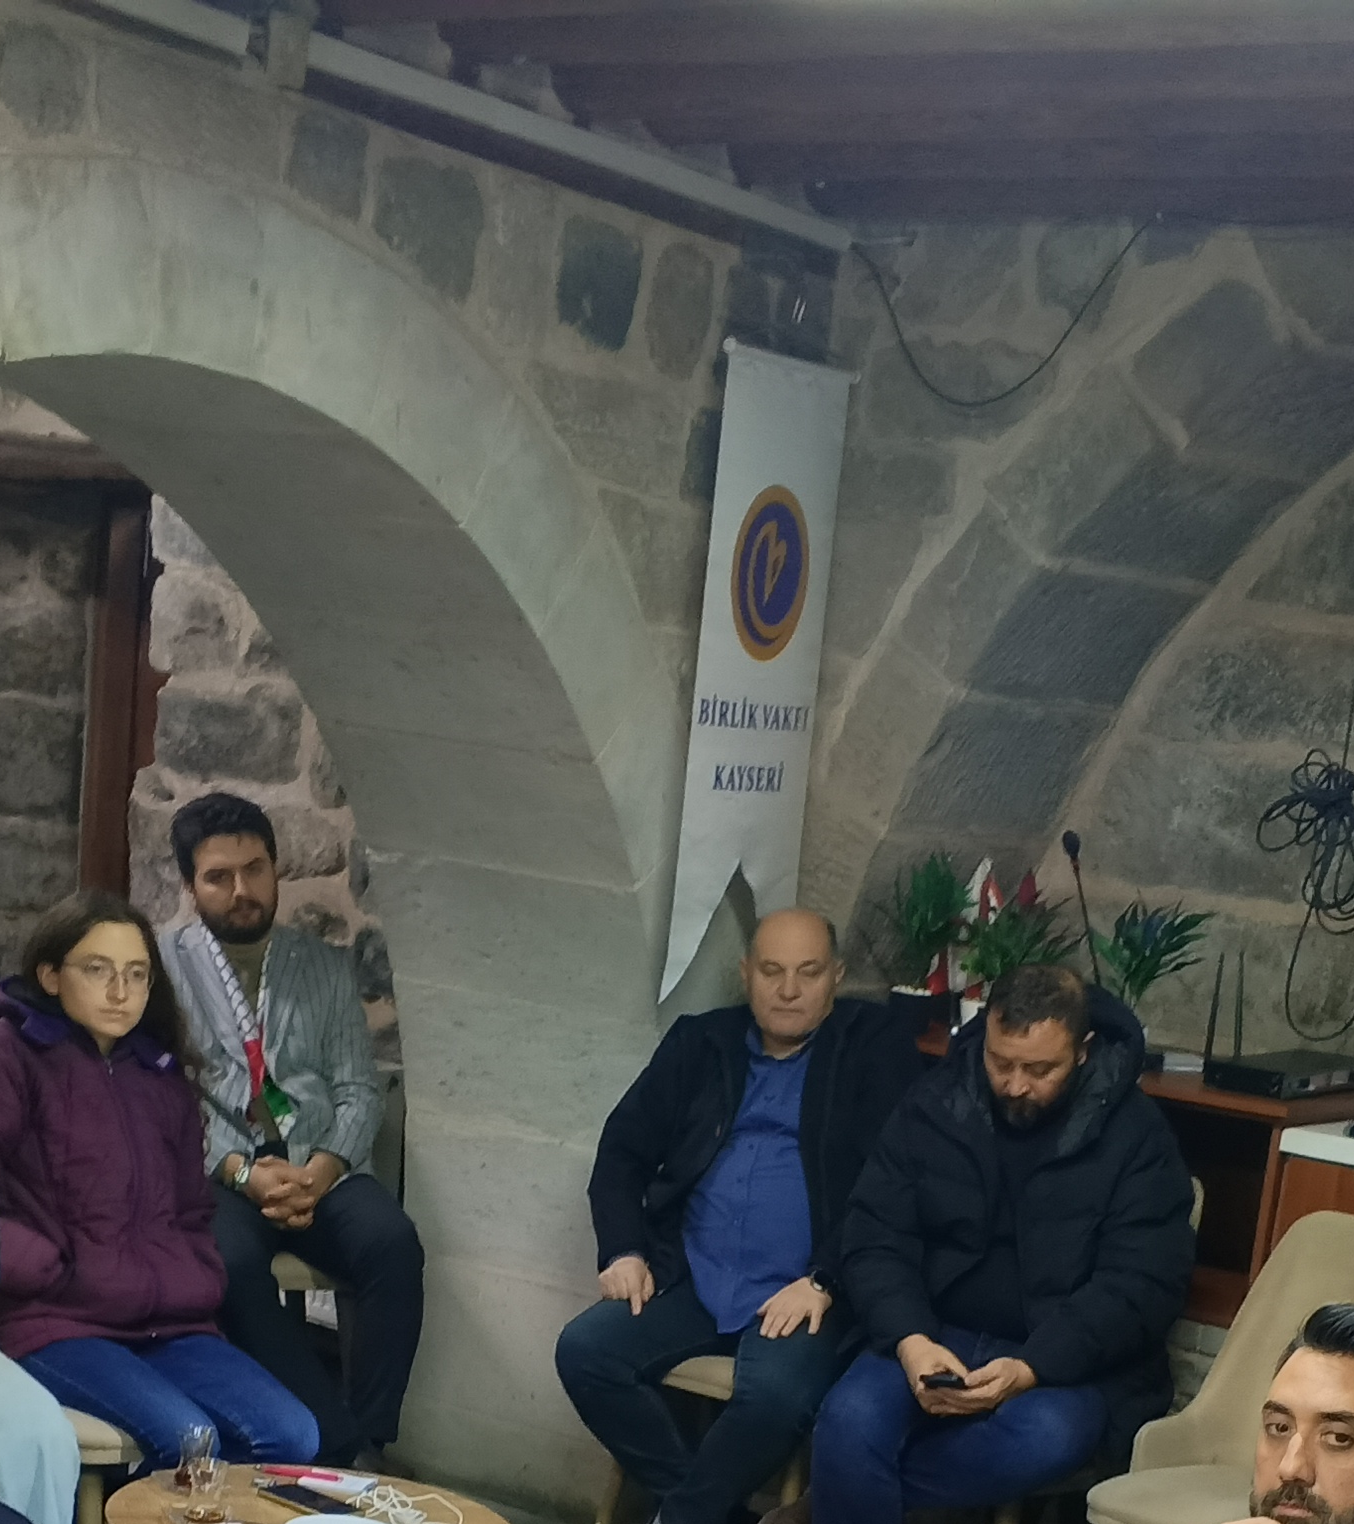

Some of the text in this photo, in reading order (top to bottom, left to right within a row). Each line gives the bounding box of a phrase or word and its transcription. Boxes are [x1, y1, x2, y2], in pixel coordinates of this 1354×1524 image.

[697, 693, 811, 732] BİRLİK VAKFI
[712, 761, 785, 793] KAYSERİ
